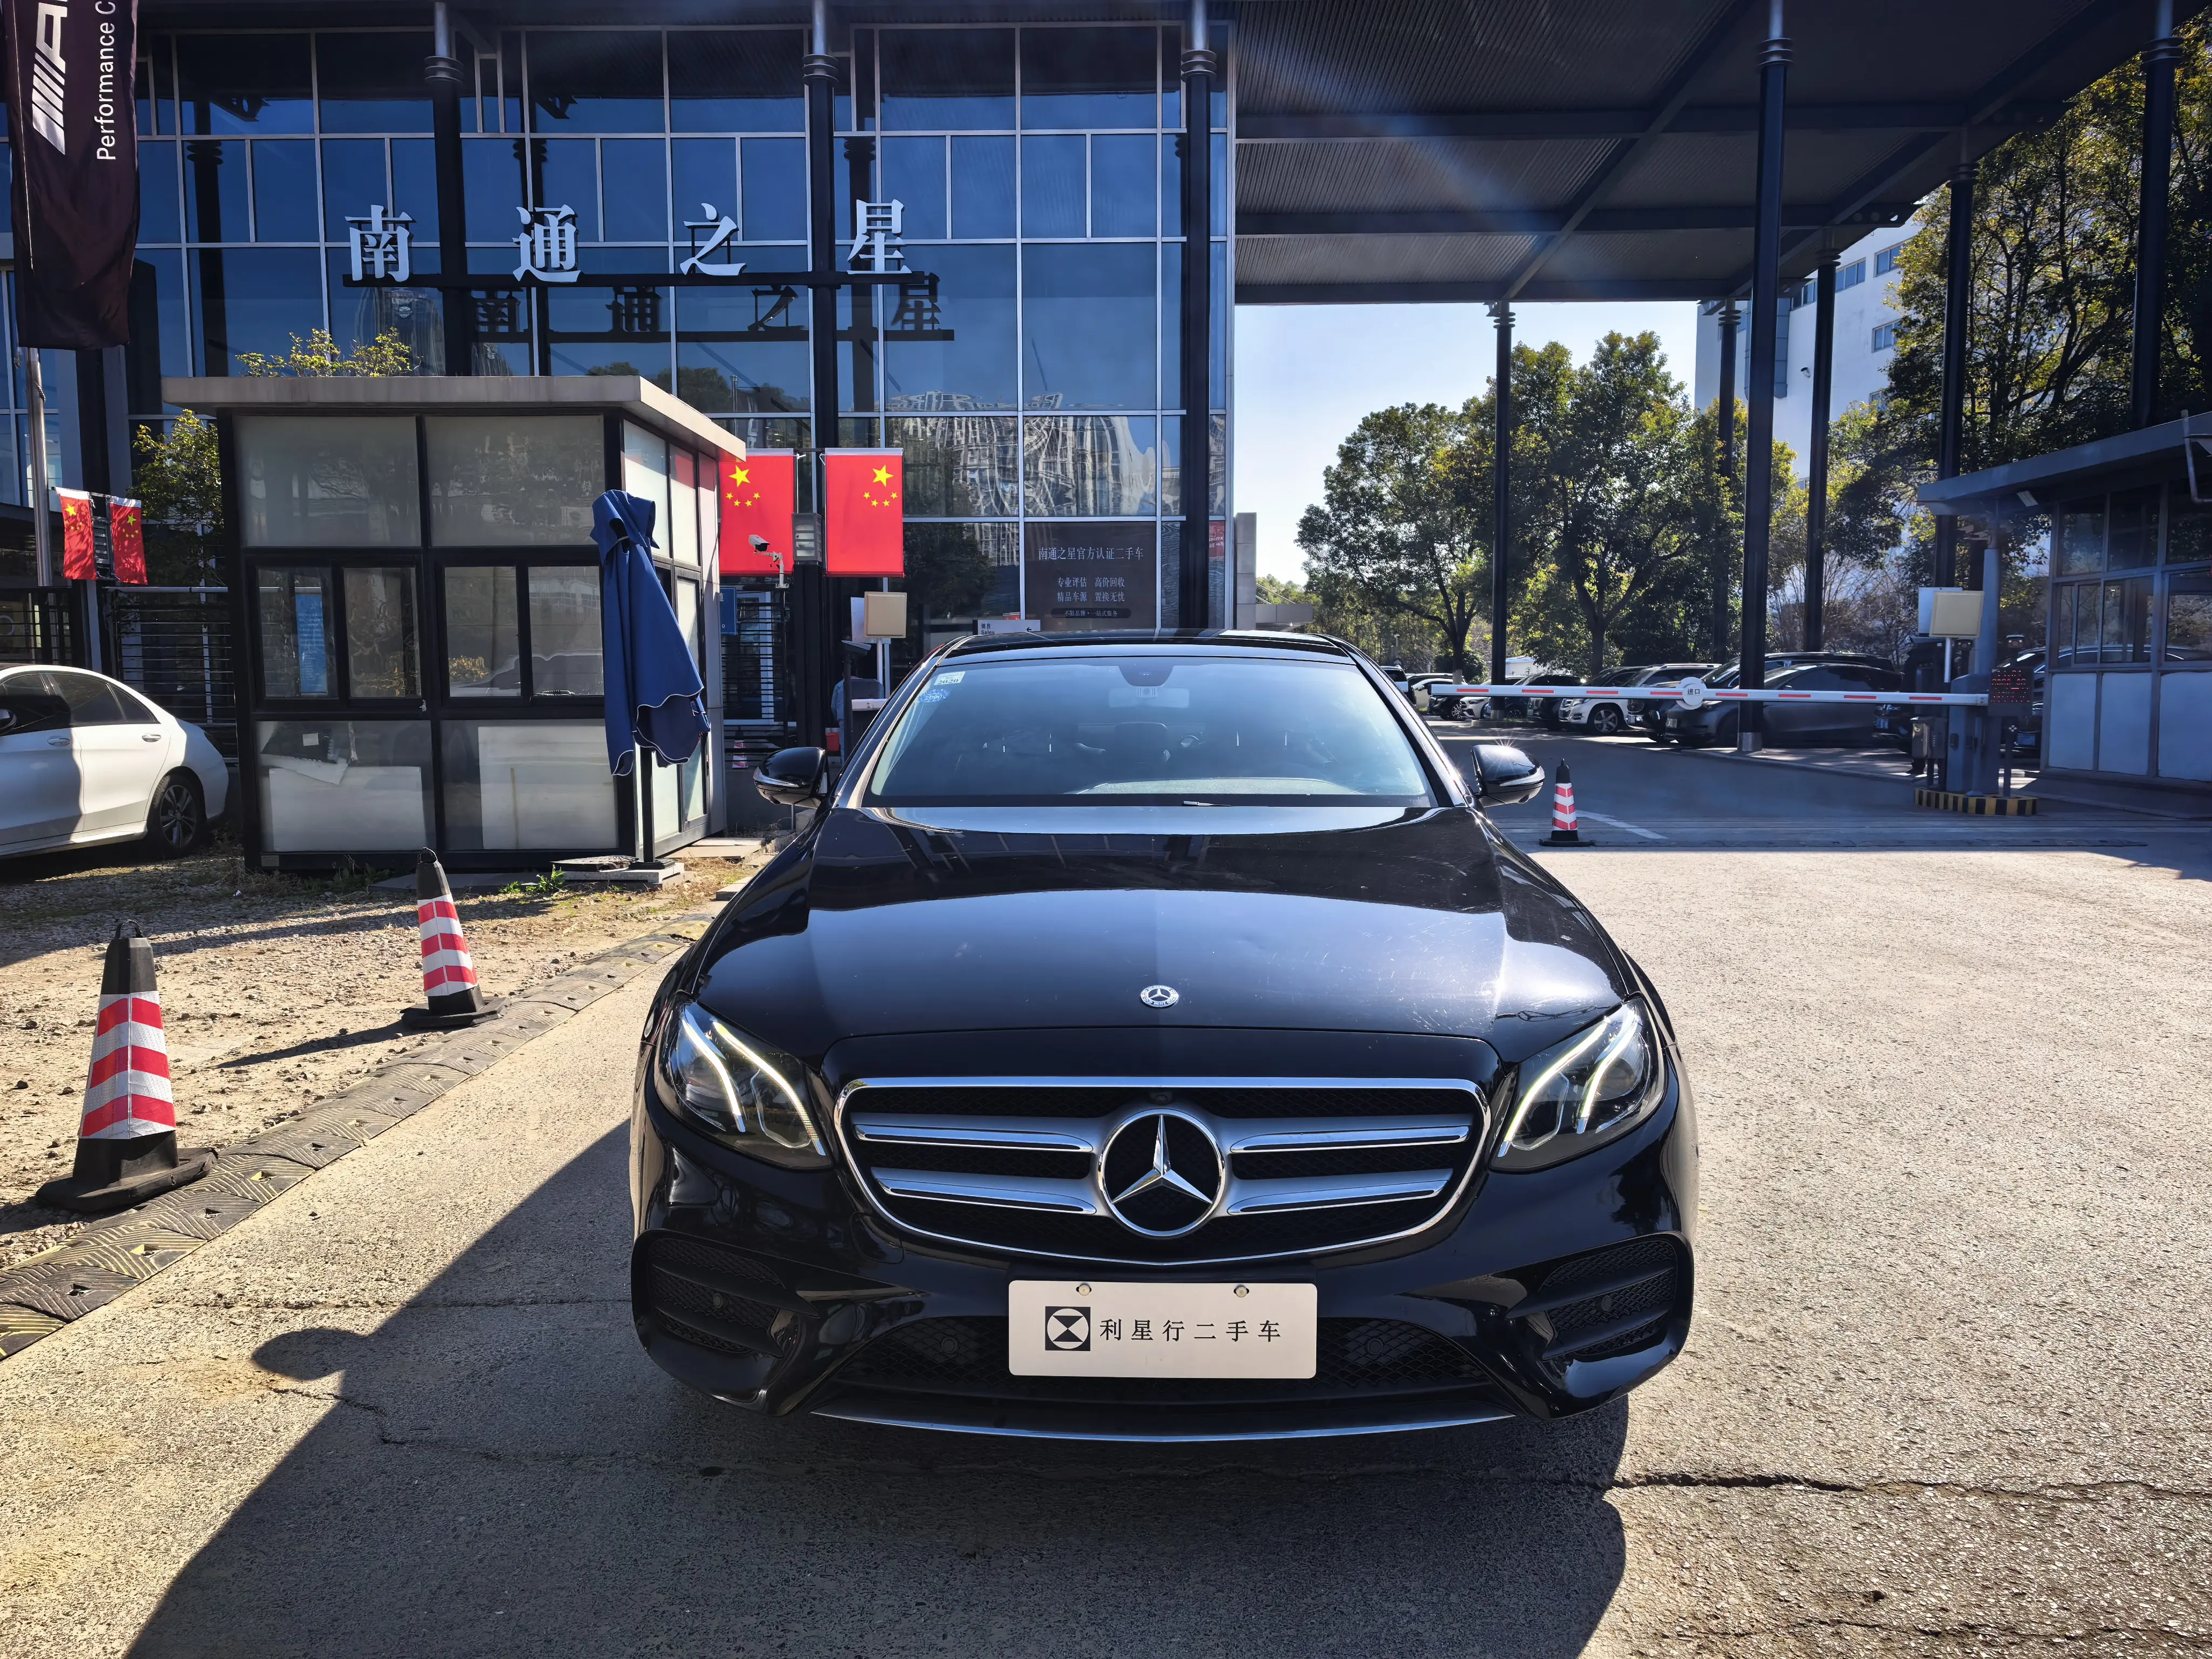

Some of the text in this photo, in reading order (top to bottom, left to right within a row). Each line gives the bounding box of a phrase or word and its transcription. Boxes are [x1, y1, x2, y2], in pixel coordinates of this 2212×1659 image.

[36, 0, 68, 73] A
[95, 22, 116, 160] Performance
[345, 199, 912, 282] 南通之星
[1038, 547, 1143, 560] 南通之星官方认证二手车
[1057, 577, 1125, 588] 专业评估 高价回收
[1057, 591, 1125, 602] 精品车源 置换无忧
[1100, 1319, 1281, 1343] 利星行二手车
